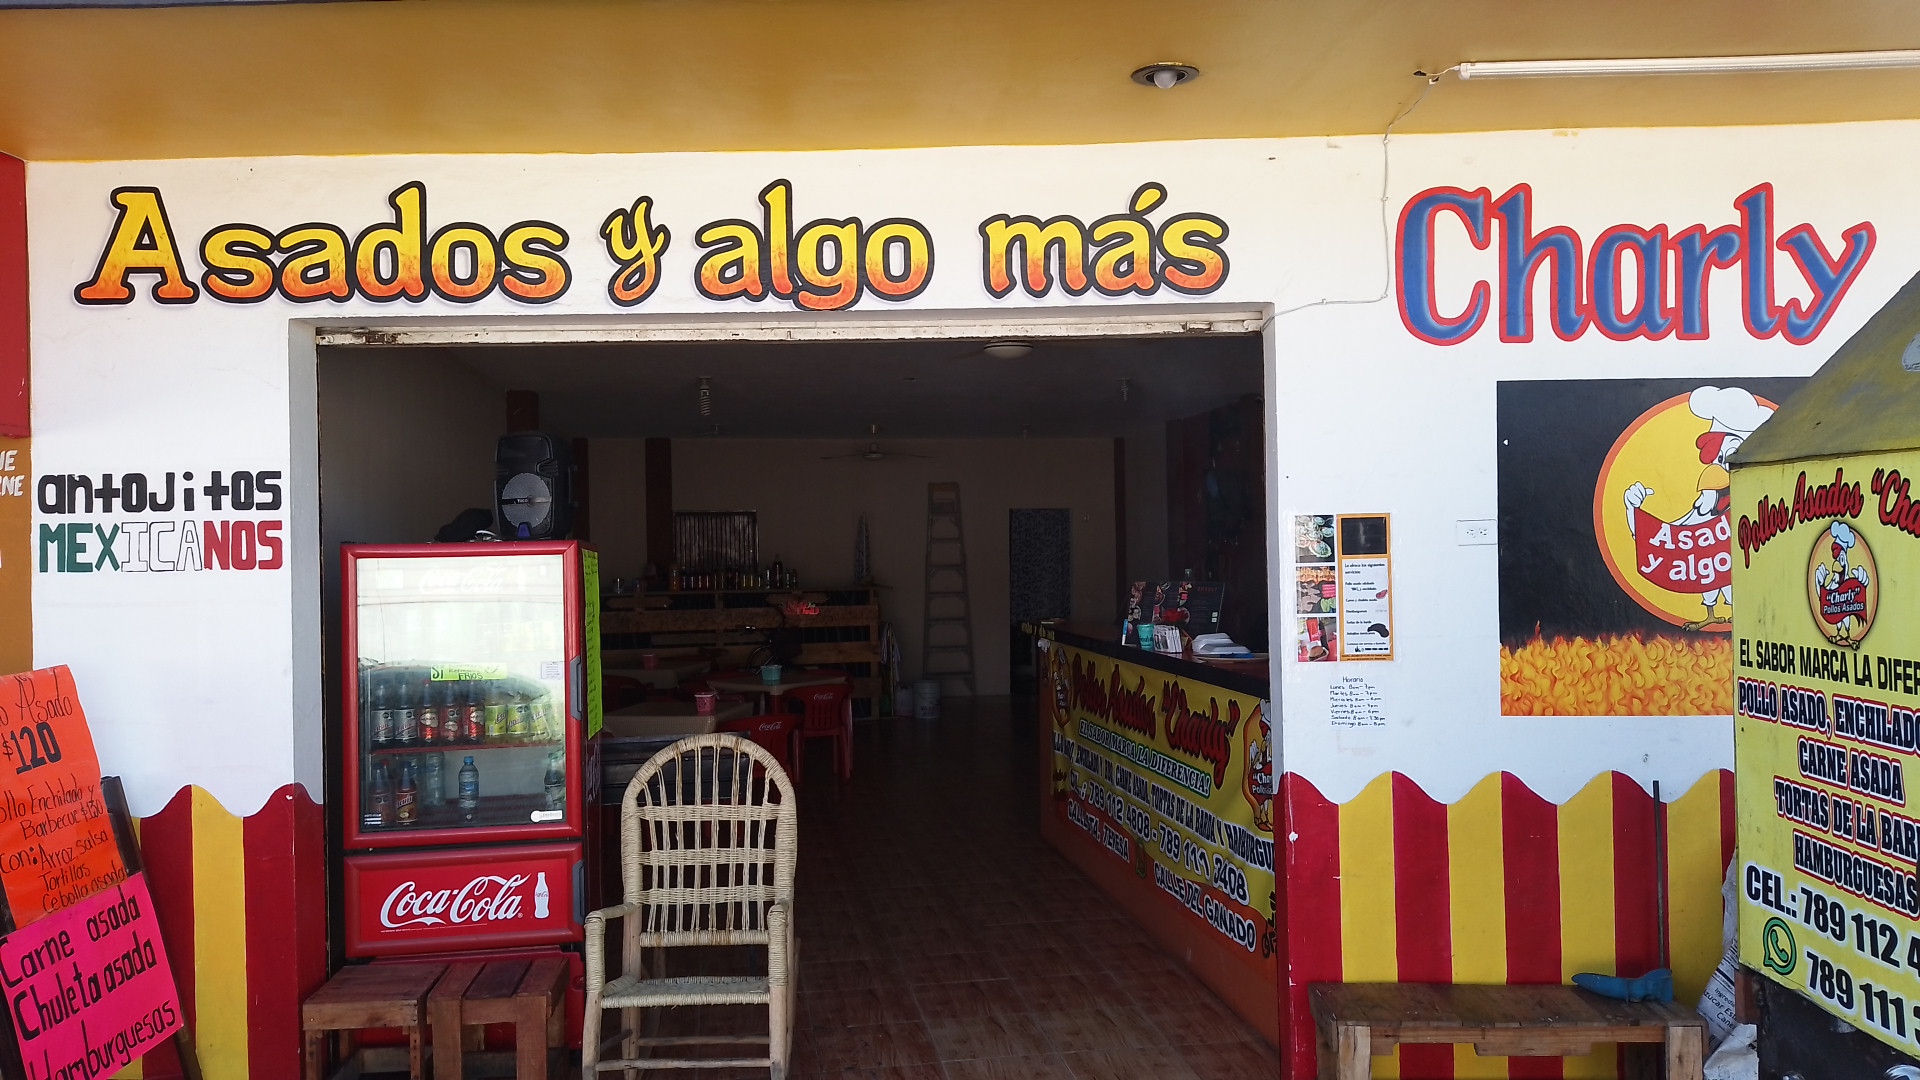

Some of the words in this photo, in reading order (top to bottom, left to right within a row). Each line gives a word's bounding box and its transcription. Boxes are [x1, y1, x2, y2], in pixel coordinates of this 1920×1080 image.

[74, 182, 569, 304] Asados
[600, 196, 670, 307] y
[695, 179, 934, 311] algo
[978, 182, 1230, 297] más
[1396, 182, 1877, 346] Charly
[0, 475, 24, 497] NE
[1738, 495, 1789, 569] Pollos
[1788, 467, 1864, 531] Asados
[39, 519, 284, 574] MEXICANOS
[1641, 553, 1664, 574] y
[1669, 552, 1731, 585] algo
[1823, 604, 1841, 614] Pollos
[1842, 602, 1864, 613] Asados
[1740, 638, 1753, 667] EL
[1756, 640, 1795, 675] SABOR
[1799, 646, 1849, 684] MARCA
[1854, 653, 1873, 688] LA
[1738, 678, 1779, 722] POLLO
[1780, 685, 1832, 739] ASADO,
[2, 722, 62, 775] $120
[1798, 735, 1848, 785] CARNE
[1849, 747, 1905, 807] ASADA
[1224, 822, 1275, 875] HAMBURGU
[1774, 776, 1830, 833] TORTAS
[1832, 794, 1855, 842] DE
[1855, 801, 1879, 852] LA
[1126, 803, 1151, 842] 4808
[1158, 821, 1182, 863] 789
[1182, 839, 1211, 881] 111
[1212, 853, 1250, 907] 3408
[1793, 829, 1920, 921] HAMBURGUESAS
[0, 930, 75, 989] Carne
[87, 884, 141, 942] asada
[380, 873, 531, 928] Coca-Cola
[1203, 894, 1257, 952] GANADO
[1800, 886, 1846, 943] 789
[1851, 913, 1901, 969] 112
[14, 961, 102, 1041] Chuleta
[103, 930, 158, 993] asada
[1806, 950, 1855, 1011] 789
[1859, 983, 1907, 1039] 111
